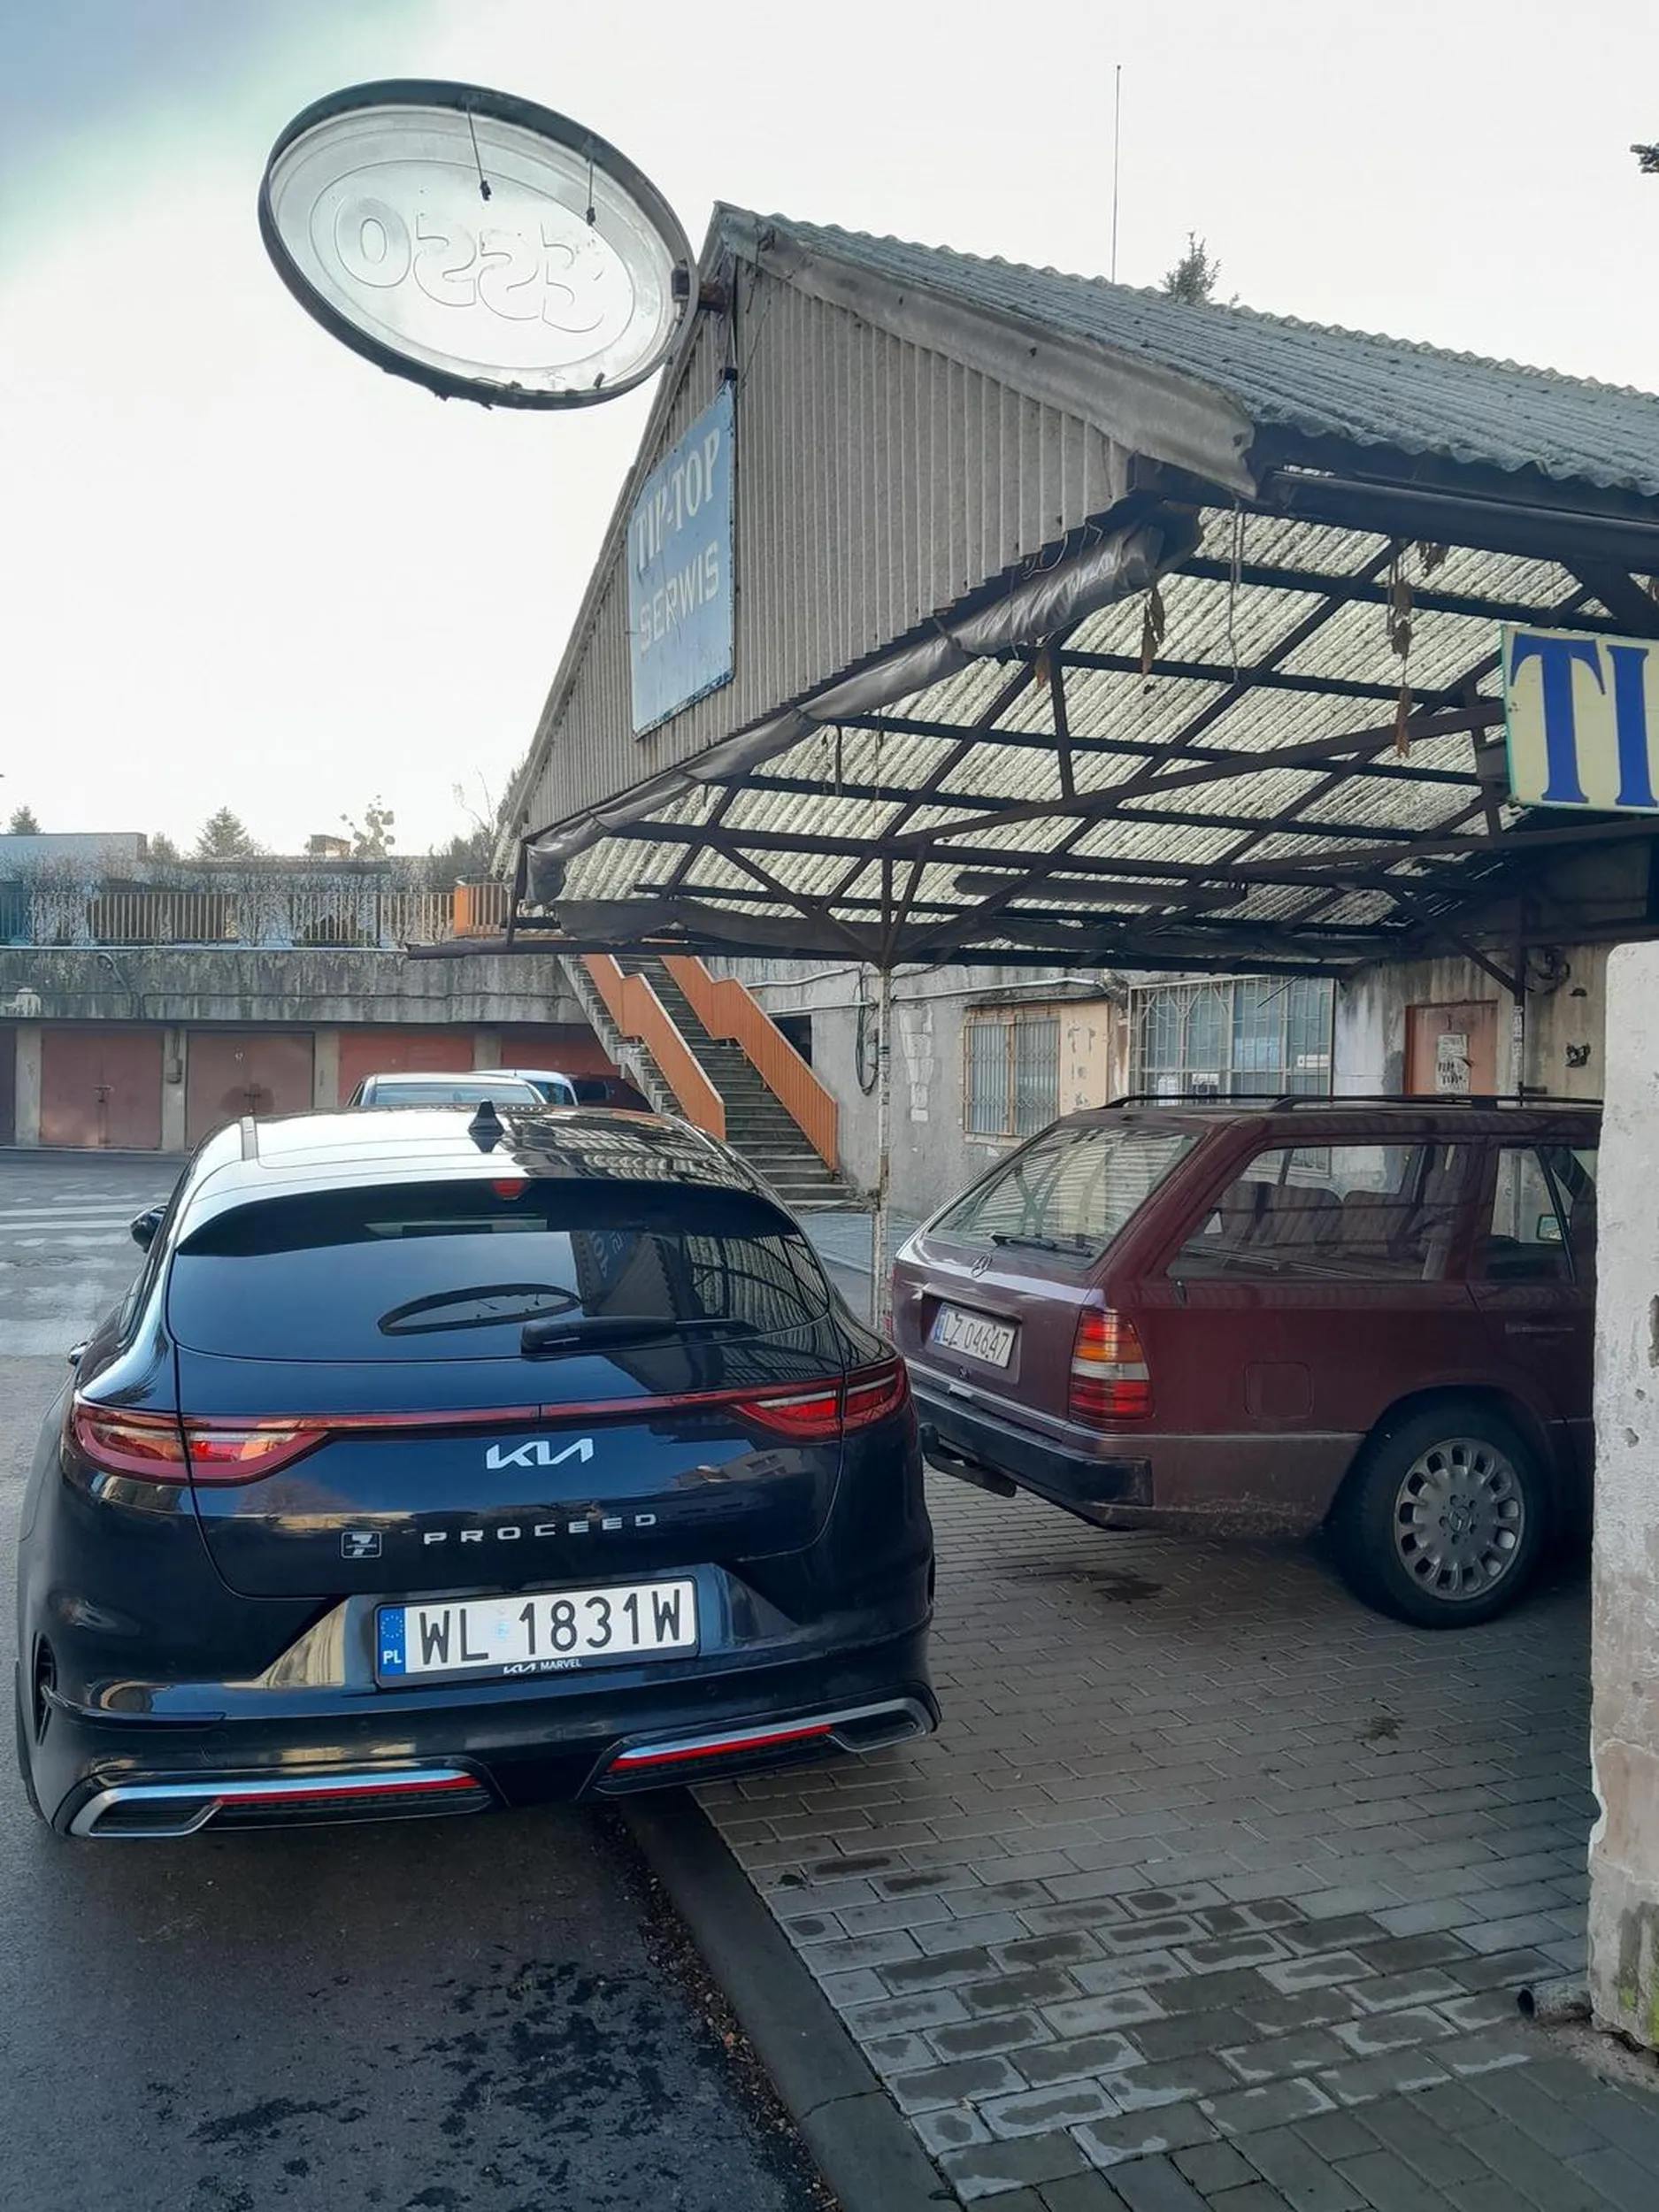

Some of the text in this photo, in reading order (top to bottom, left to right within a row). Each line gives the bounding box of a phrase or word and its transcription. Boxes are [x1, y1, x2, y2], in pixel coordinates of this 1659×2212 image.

[635, 427, 721, 572] TIP-TOP
[639, 541, 719, 653] SERWIS
[486, 1438, 594, 1470] KIA
[423, 1513, 657, 1546] PROCEED
[419, 1589, 680, 1665] WL 1831W
[382, 1650, 403, 1665] PL
[540, 1658, 582, 1672] MARVEL
